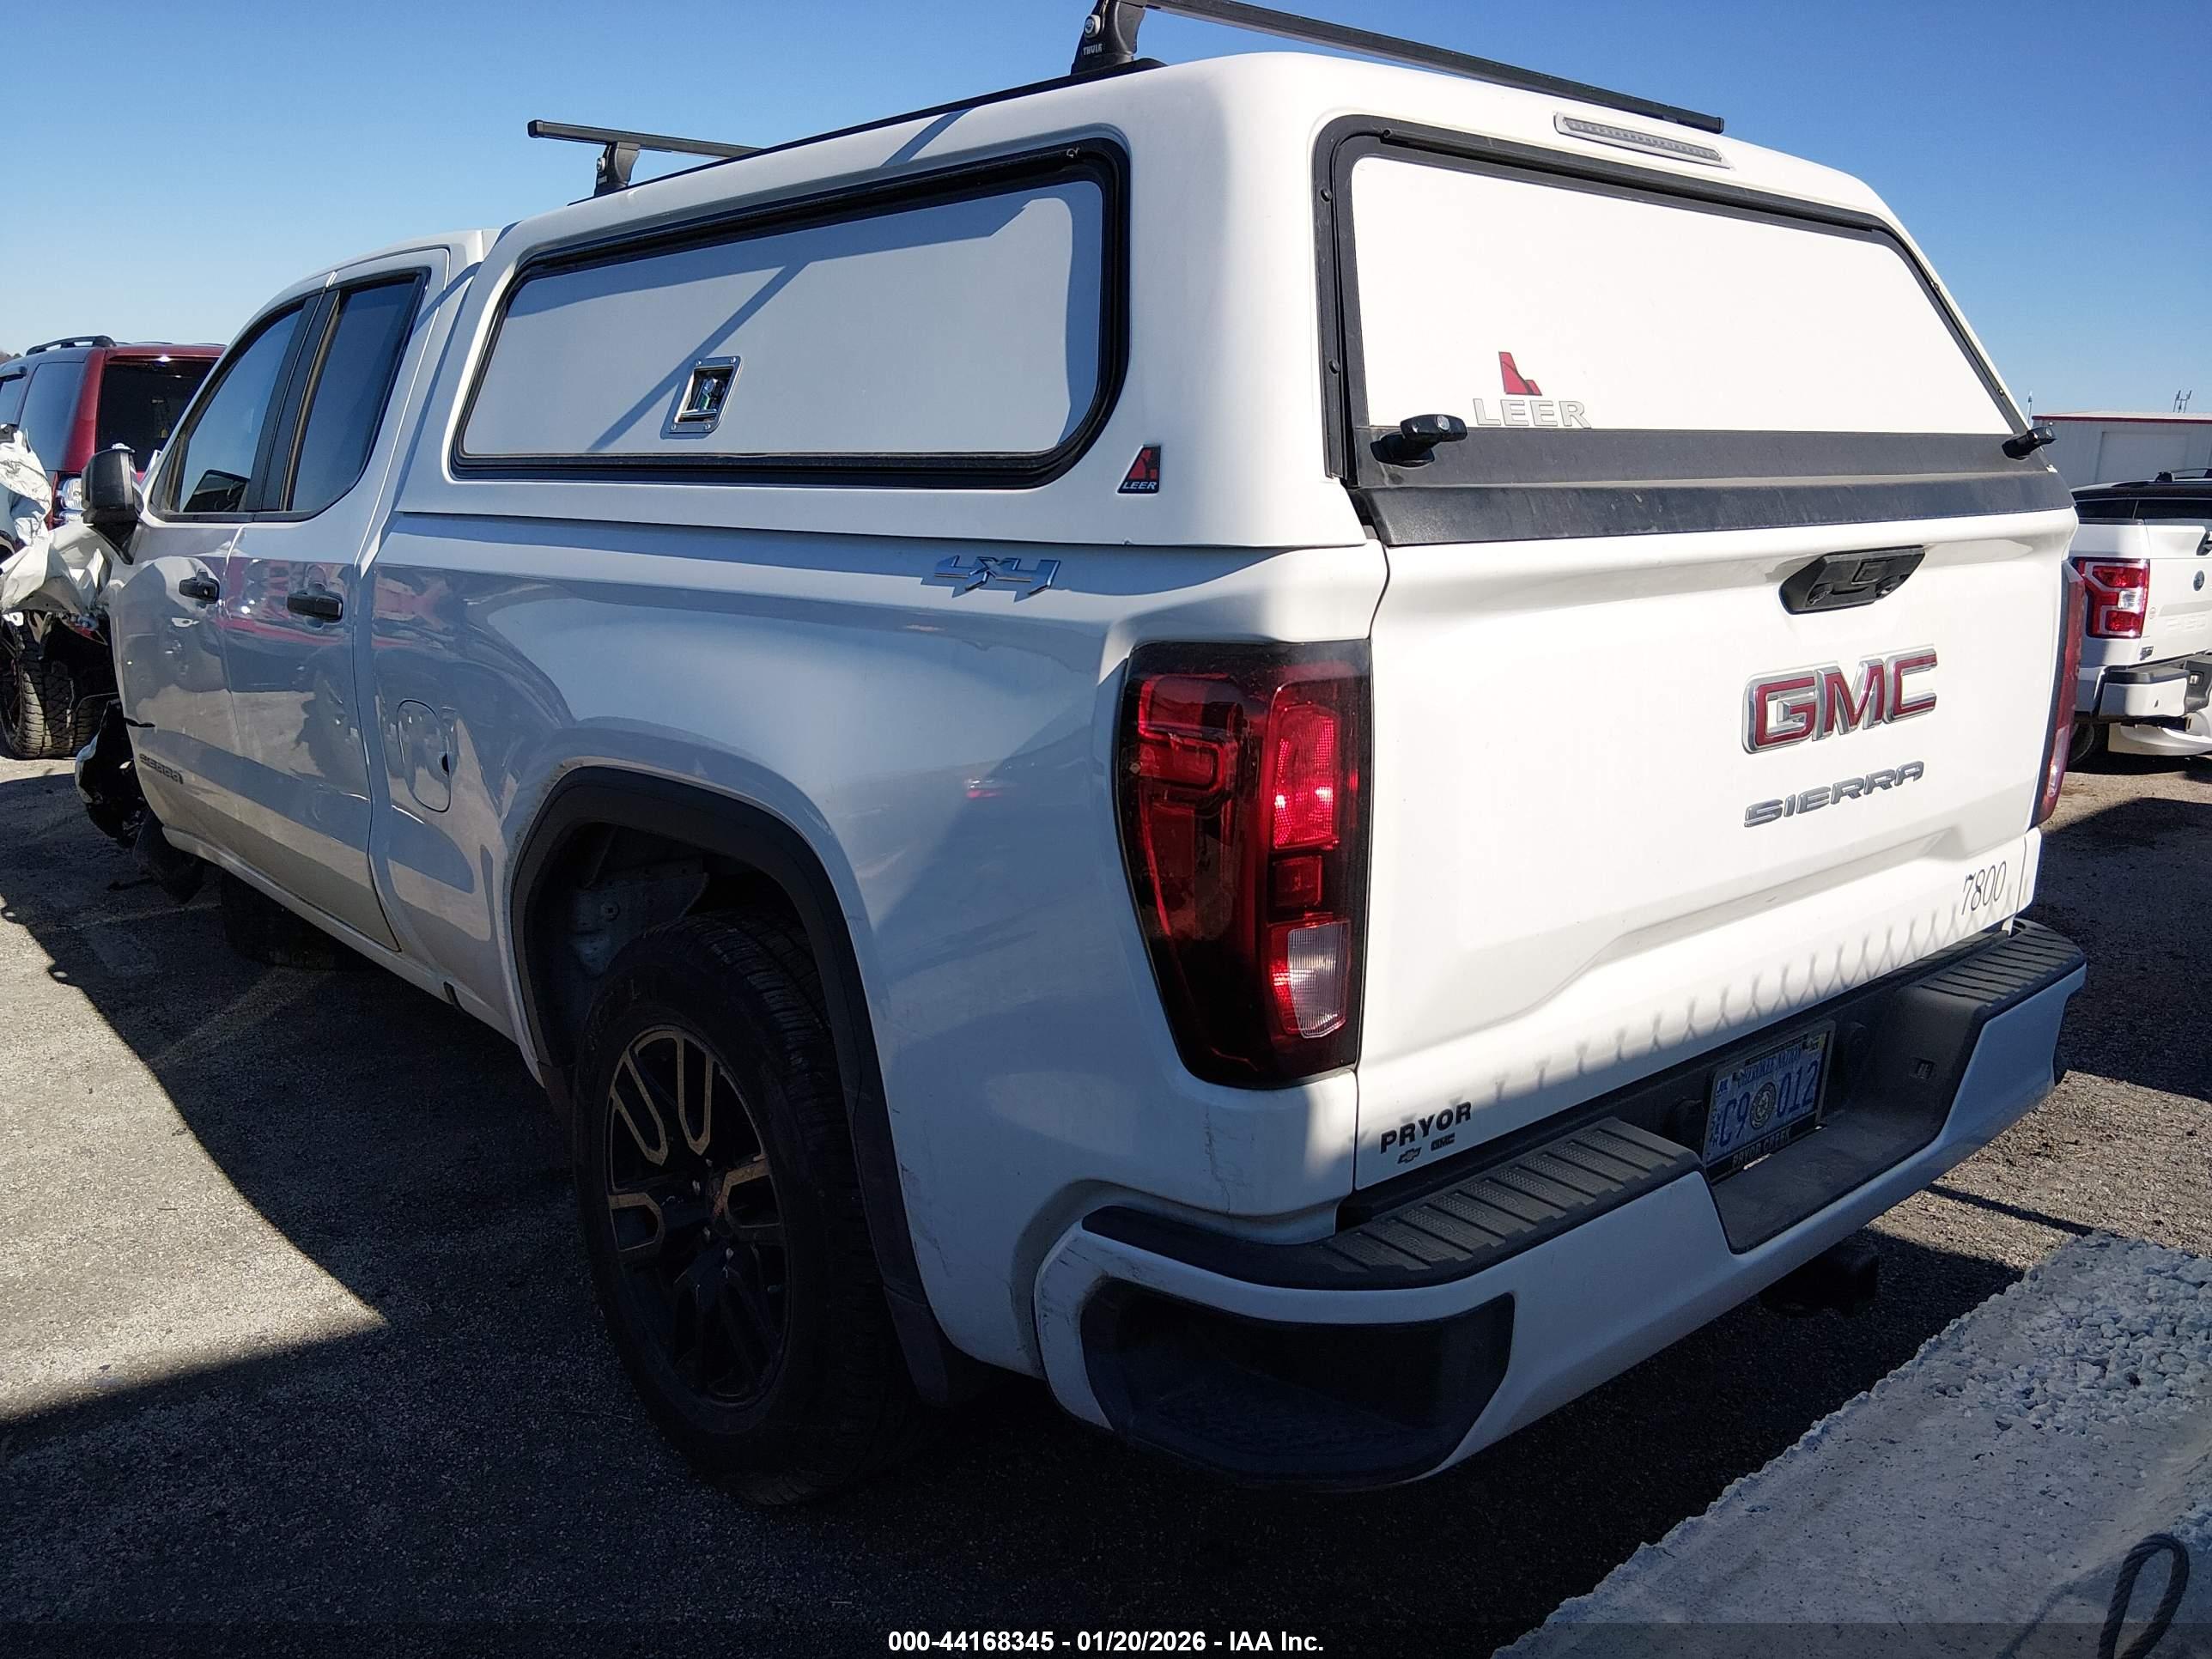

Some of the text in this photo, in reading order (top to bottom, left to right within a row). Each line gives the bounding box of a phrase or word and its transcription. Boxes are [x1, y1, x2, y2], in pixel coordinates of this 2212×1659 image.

[1472, 398, 1592, 429] LEER
[1121, 481, 1158, 490] LEER
[1742, 647, 1938, 754] GMC
[1744, 761, 1924, 828] SIERRA
[1960, 860, 2007, 915] 7800
[1380, 1101, 1472, 1154] PRYOR
